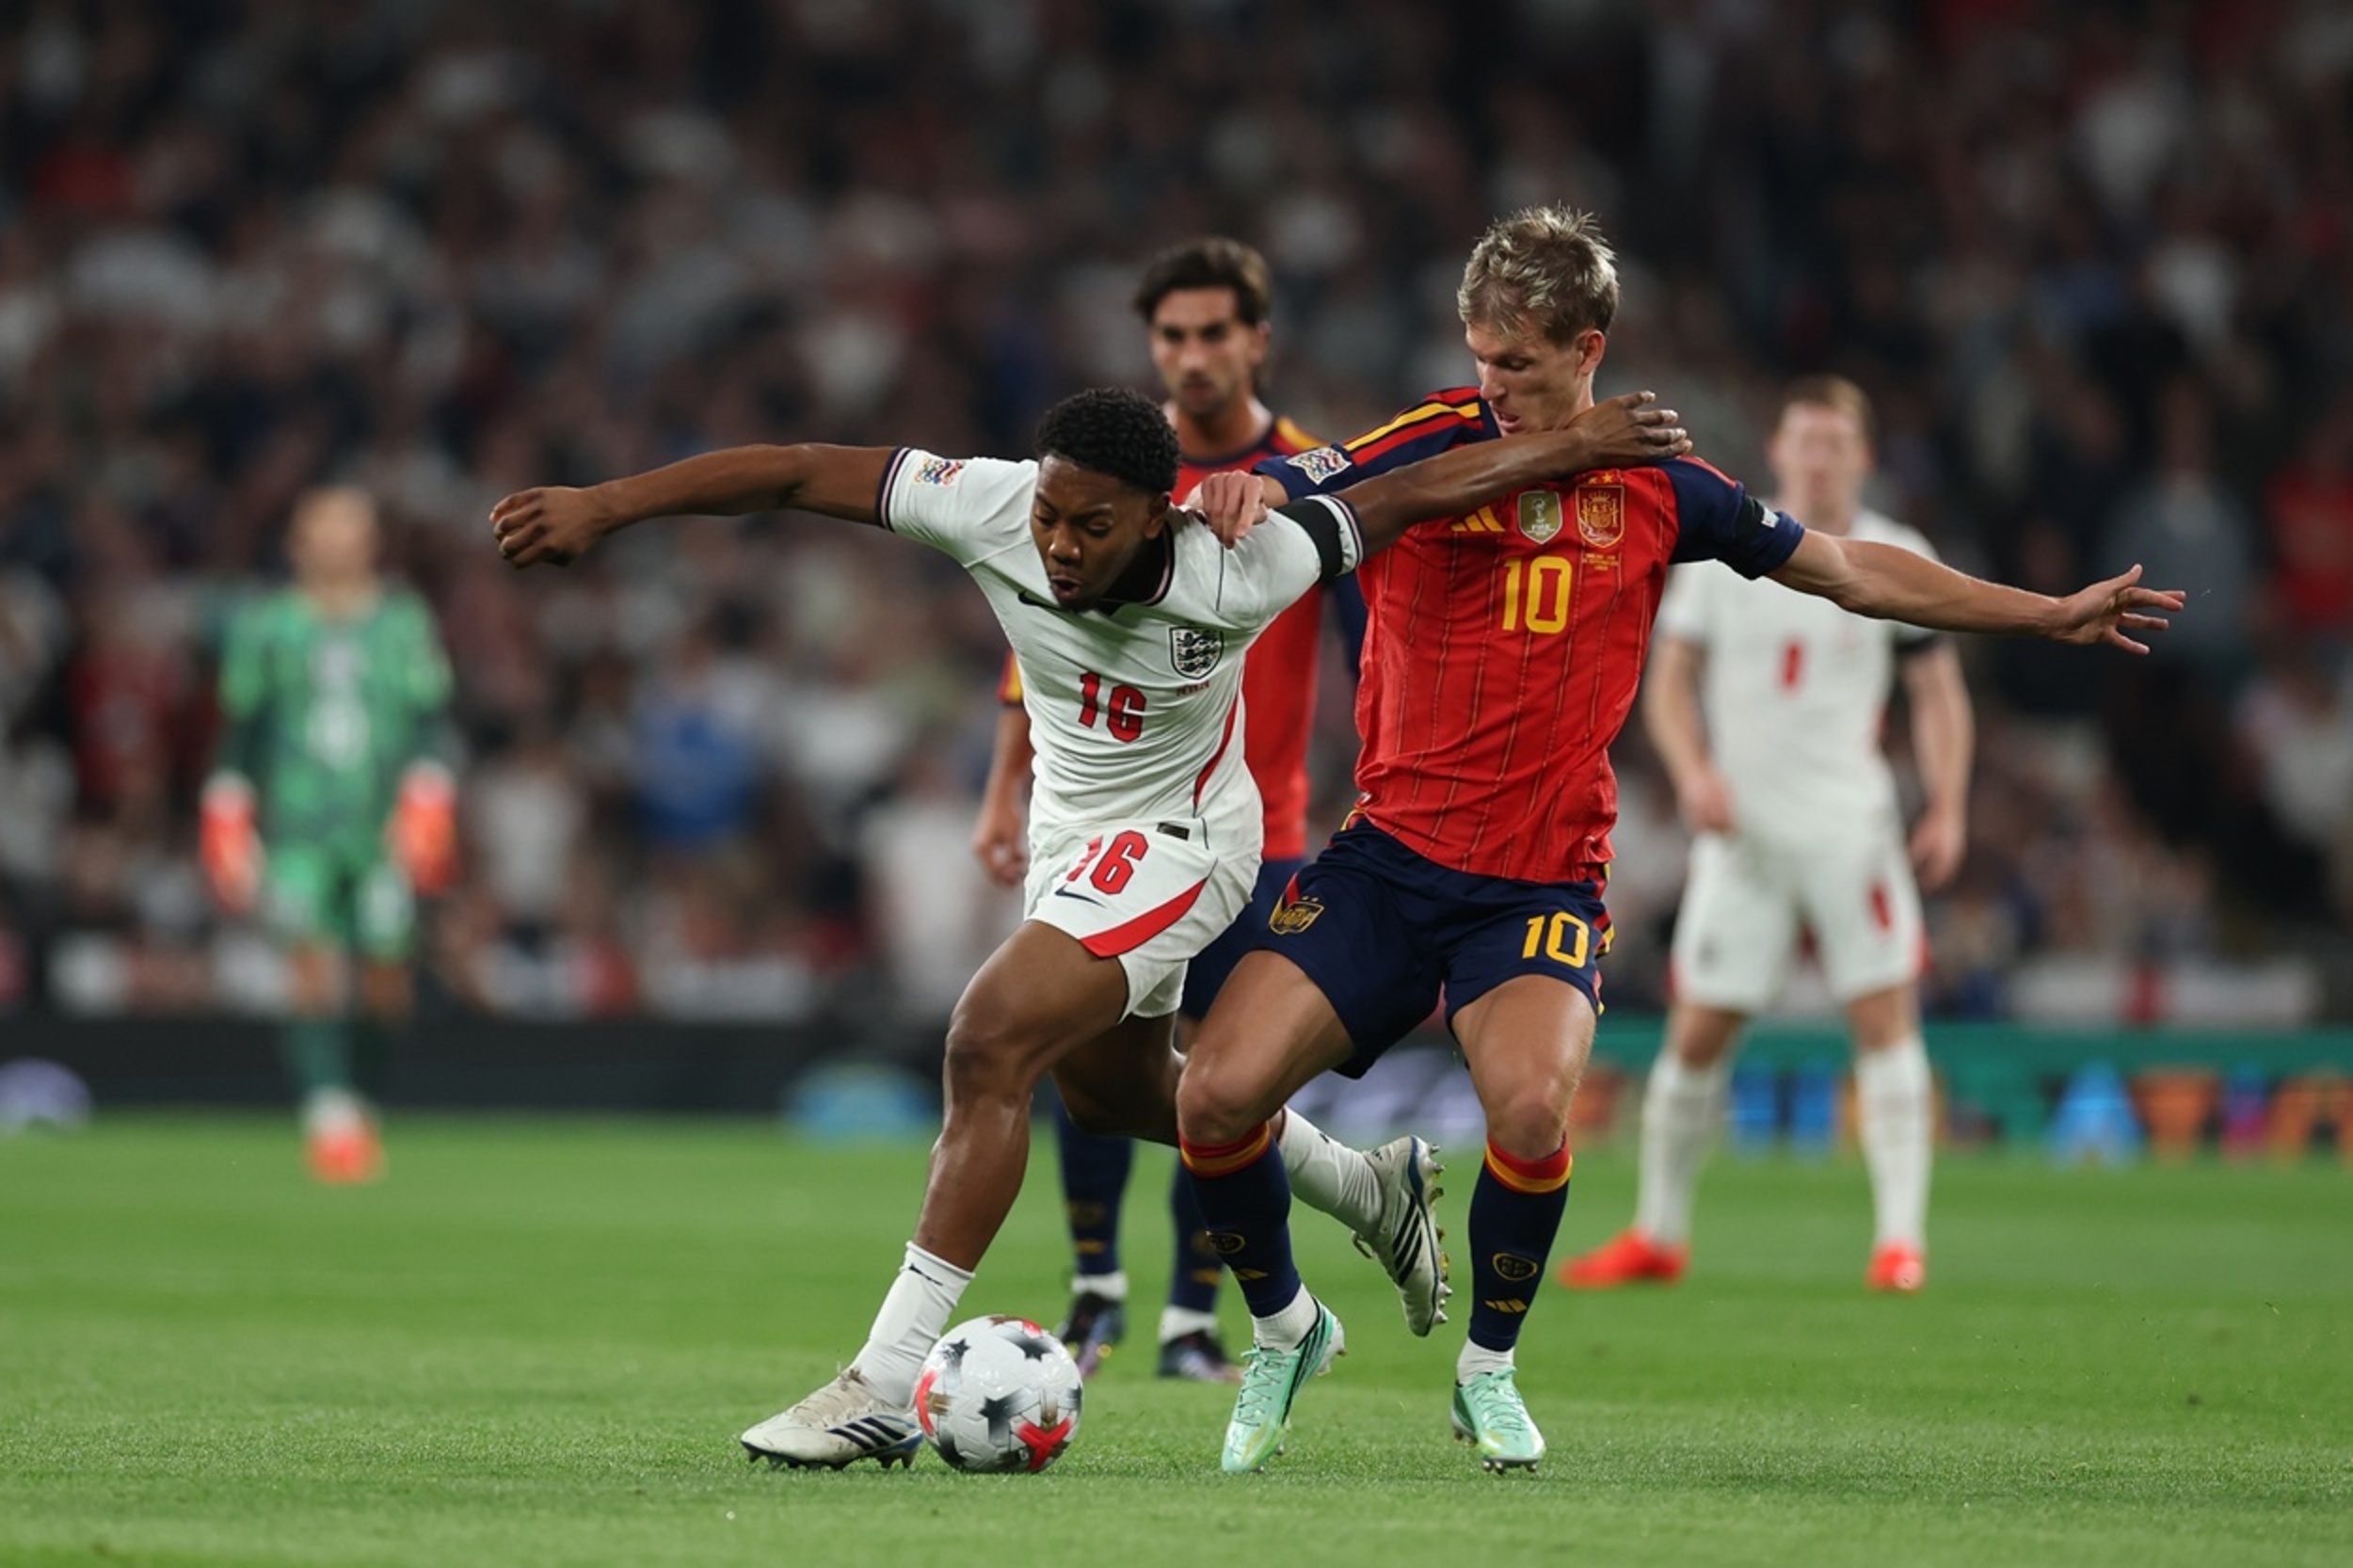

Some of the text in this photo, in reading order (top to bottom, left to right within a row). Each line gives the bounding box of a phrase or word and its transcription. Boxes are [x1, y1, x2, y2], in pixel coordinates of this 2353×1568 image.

[1502, 556, 1572, 633] 10
[1078, 671, 1146, 744] 16
[1065, 829, 1149, 895] 16
[1522, 909, 1590, 968] 10
